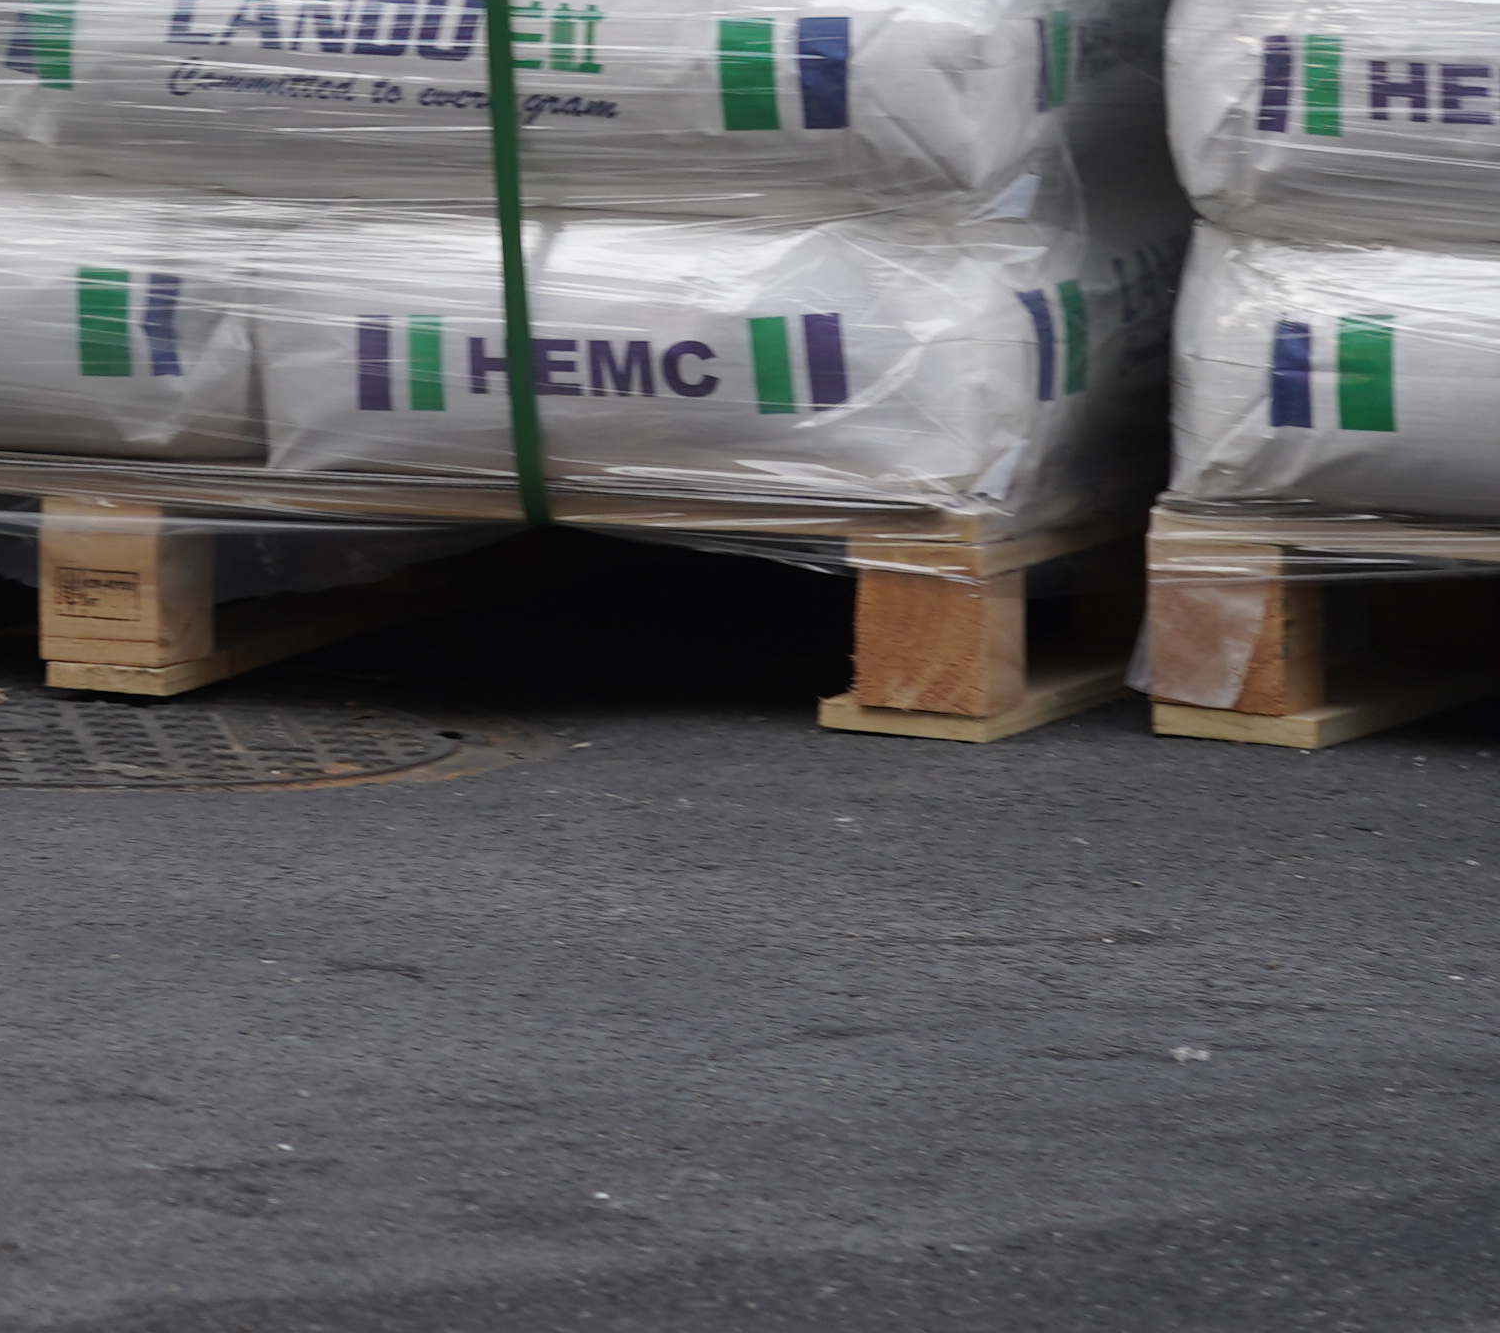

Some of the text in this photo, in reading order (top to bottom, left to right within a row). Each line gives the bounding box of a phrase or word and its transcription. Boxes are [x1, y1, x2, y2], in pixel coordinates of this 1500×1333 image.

[167, 57, 357, 103] Committed
[370, 78, 405, 106] to
[517, 92, 622, 127] gram
[467, 333, 722, 400] HEMC
